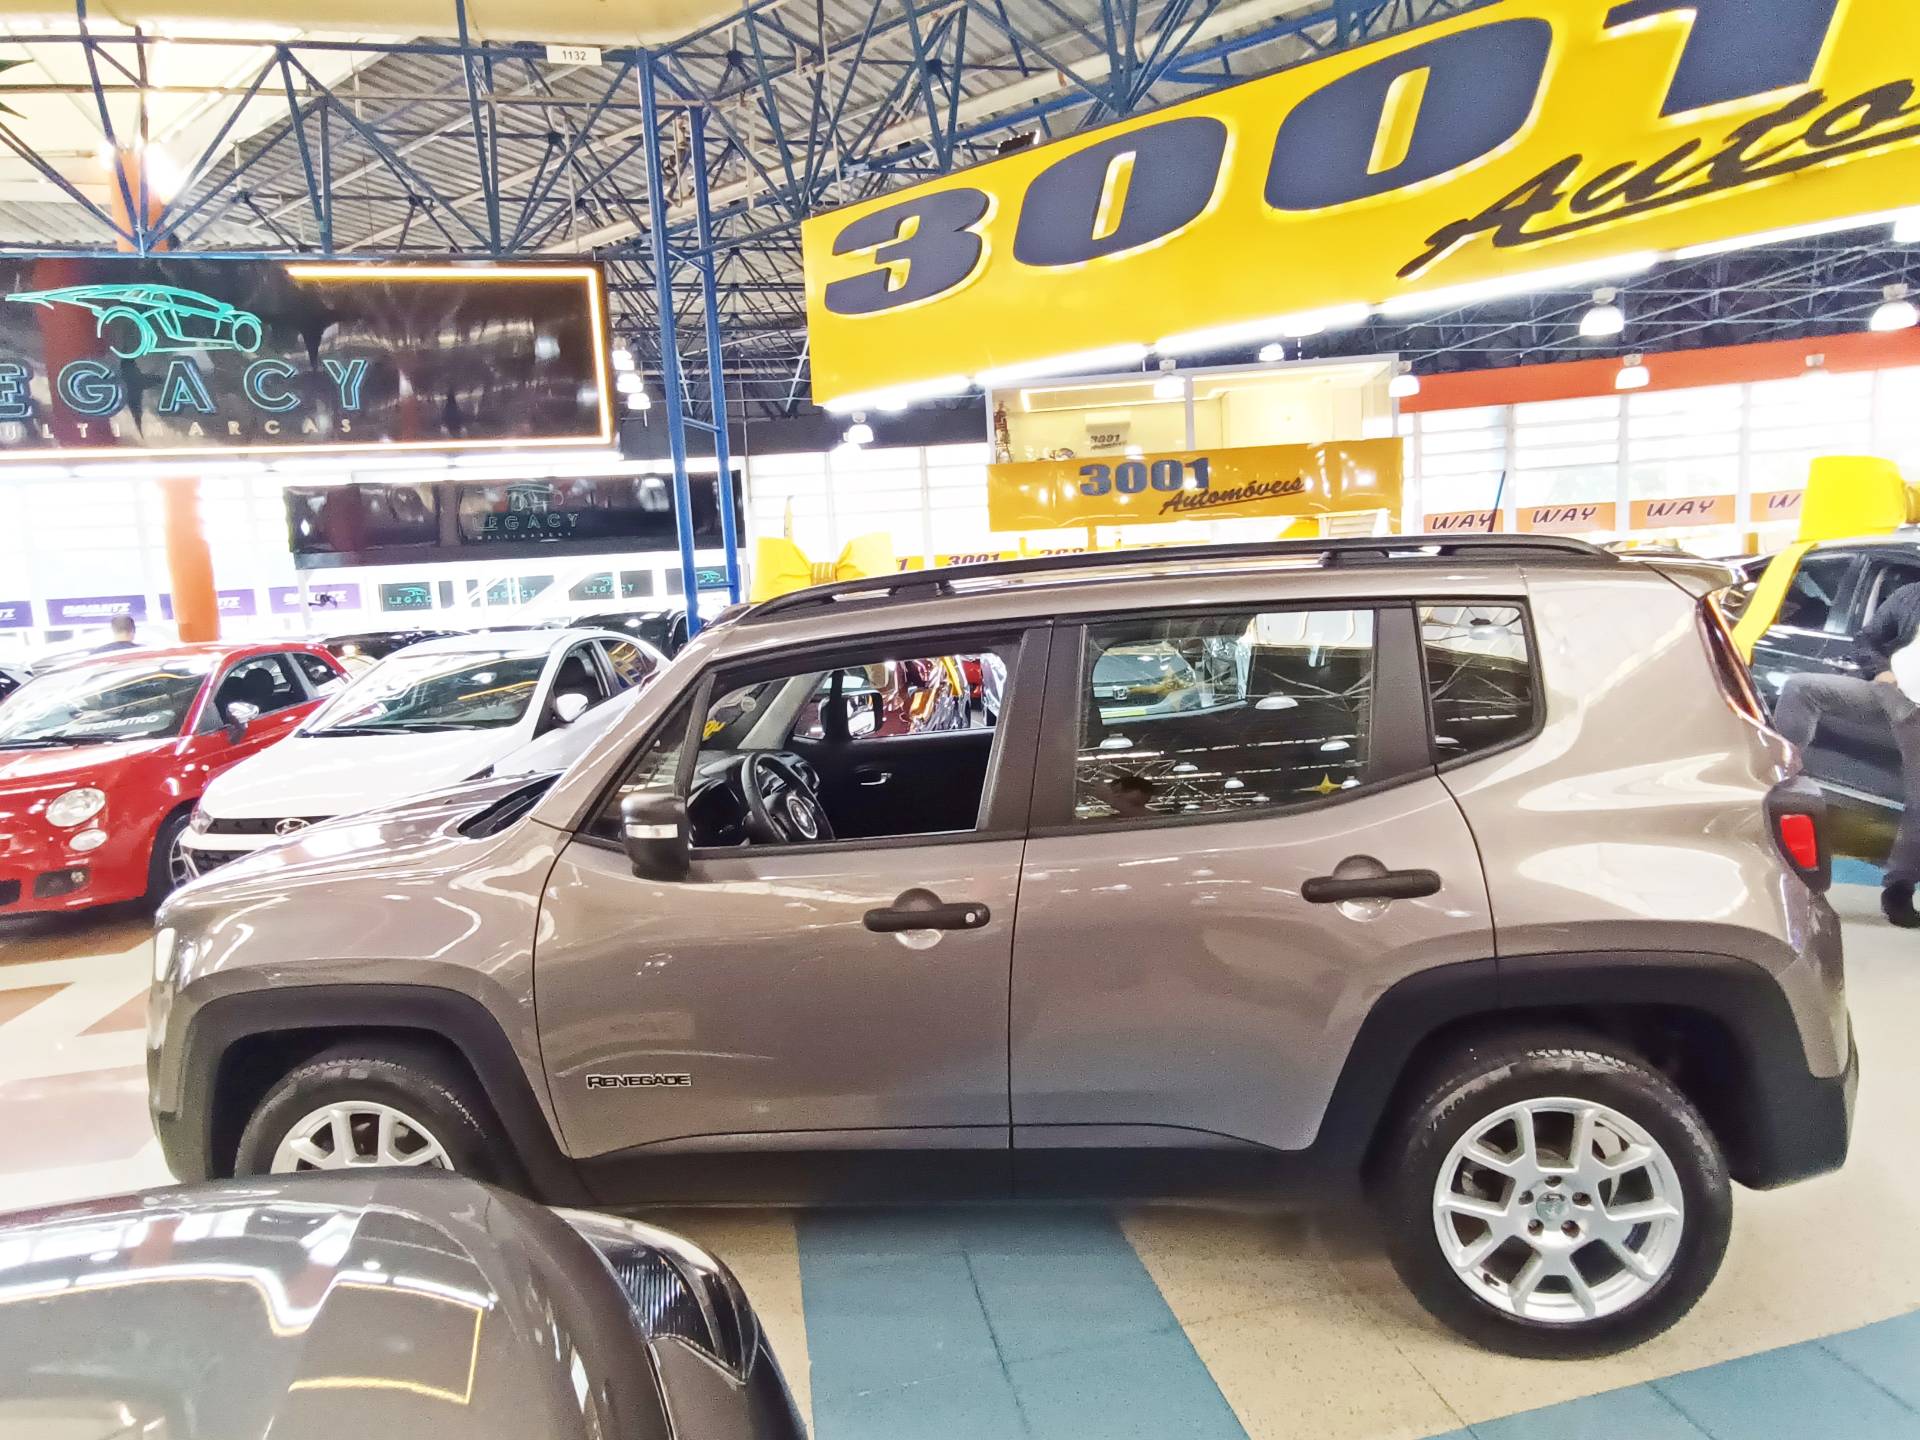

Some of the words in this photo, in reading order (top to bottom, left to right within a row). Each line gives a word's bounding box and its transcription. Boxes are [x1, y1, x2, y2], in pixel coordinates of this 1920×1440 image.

[562, 50, 586, 61] 1132
[824, 0, 1840, 315] 3001
[1079, 457, 1209, 496] 3001
[1532, 507, 1597, 523] WAY
[1646, 500, 1715, 517] WAY
[472, 513, 579, 532] LEGACY
[1432, 513, 1493, 530] WAY
[586, 1073, 692, 1089] RENEGADE
